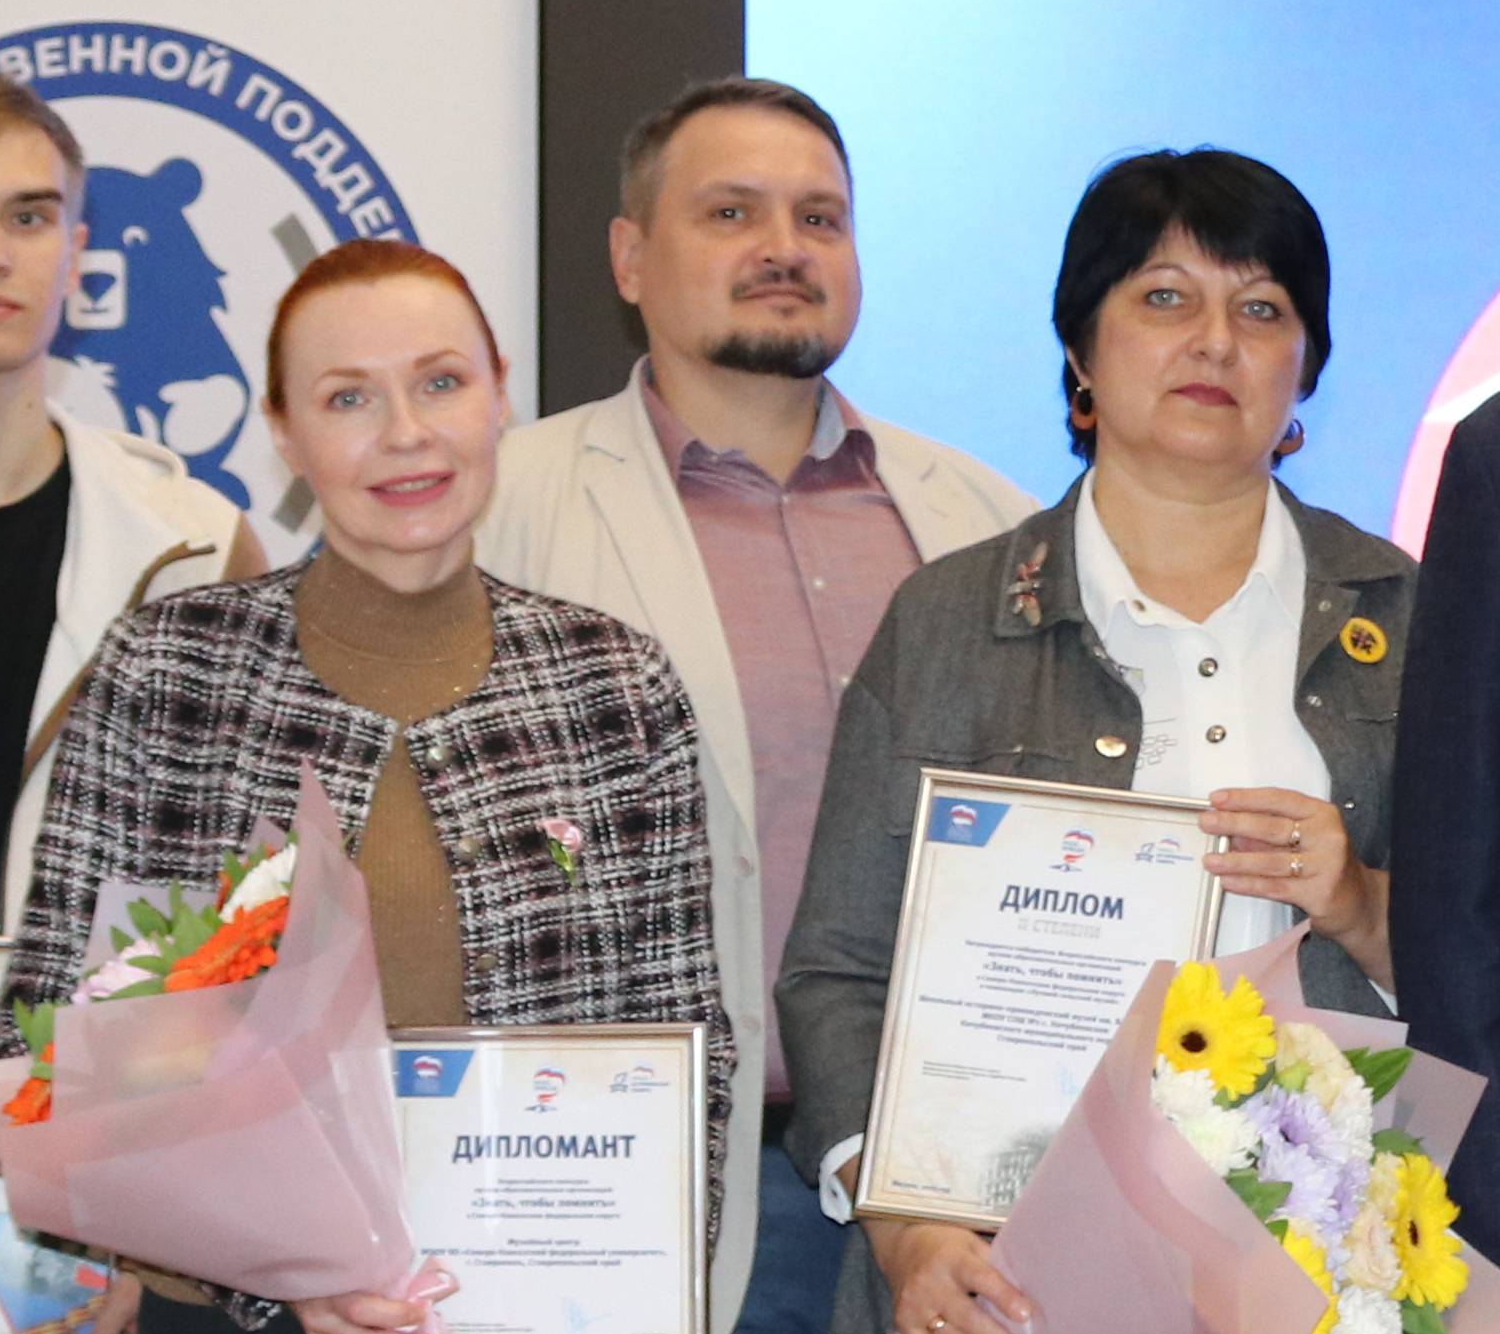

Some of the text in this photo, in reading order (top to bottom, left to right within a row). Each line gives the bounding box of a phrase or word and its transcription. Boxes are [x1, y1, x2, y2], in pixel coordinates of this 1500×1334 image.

[235, 73, 405, 242] ПОДДЕ
[999, 884, 1125, 920] ДИПЛОМ
[452, 1134, 635, 1164] ДИПЛОМАНТ
